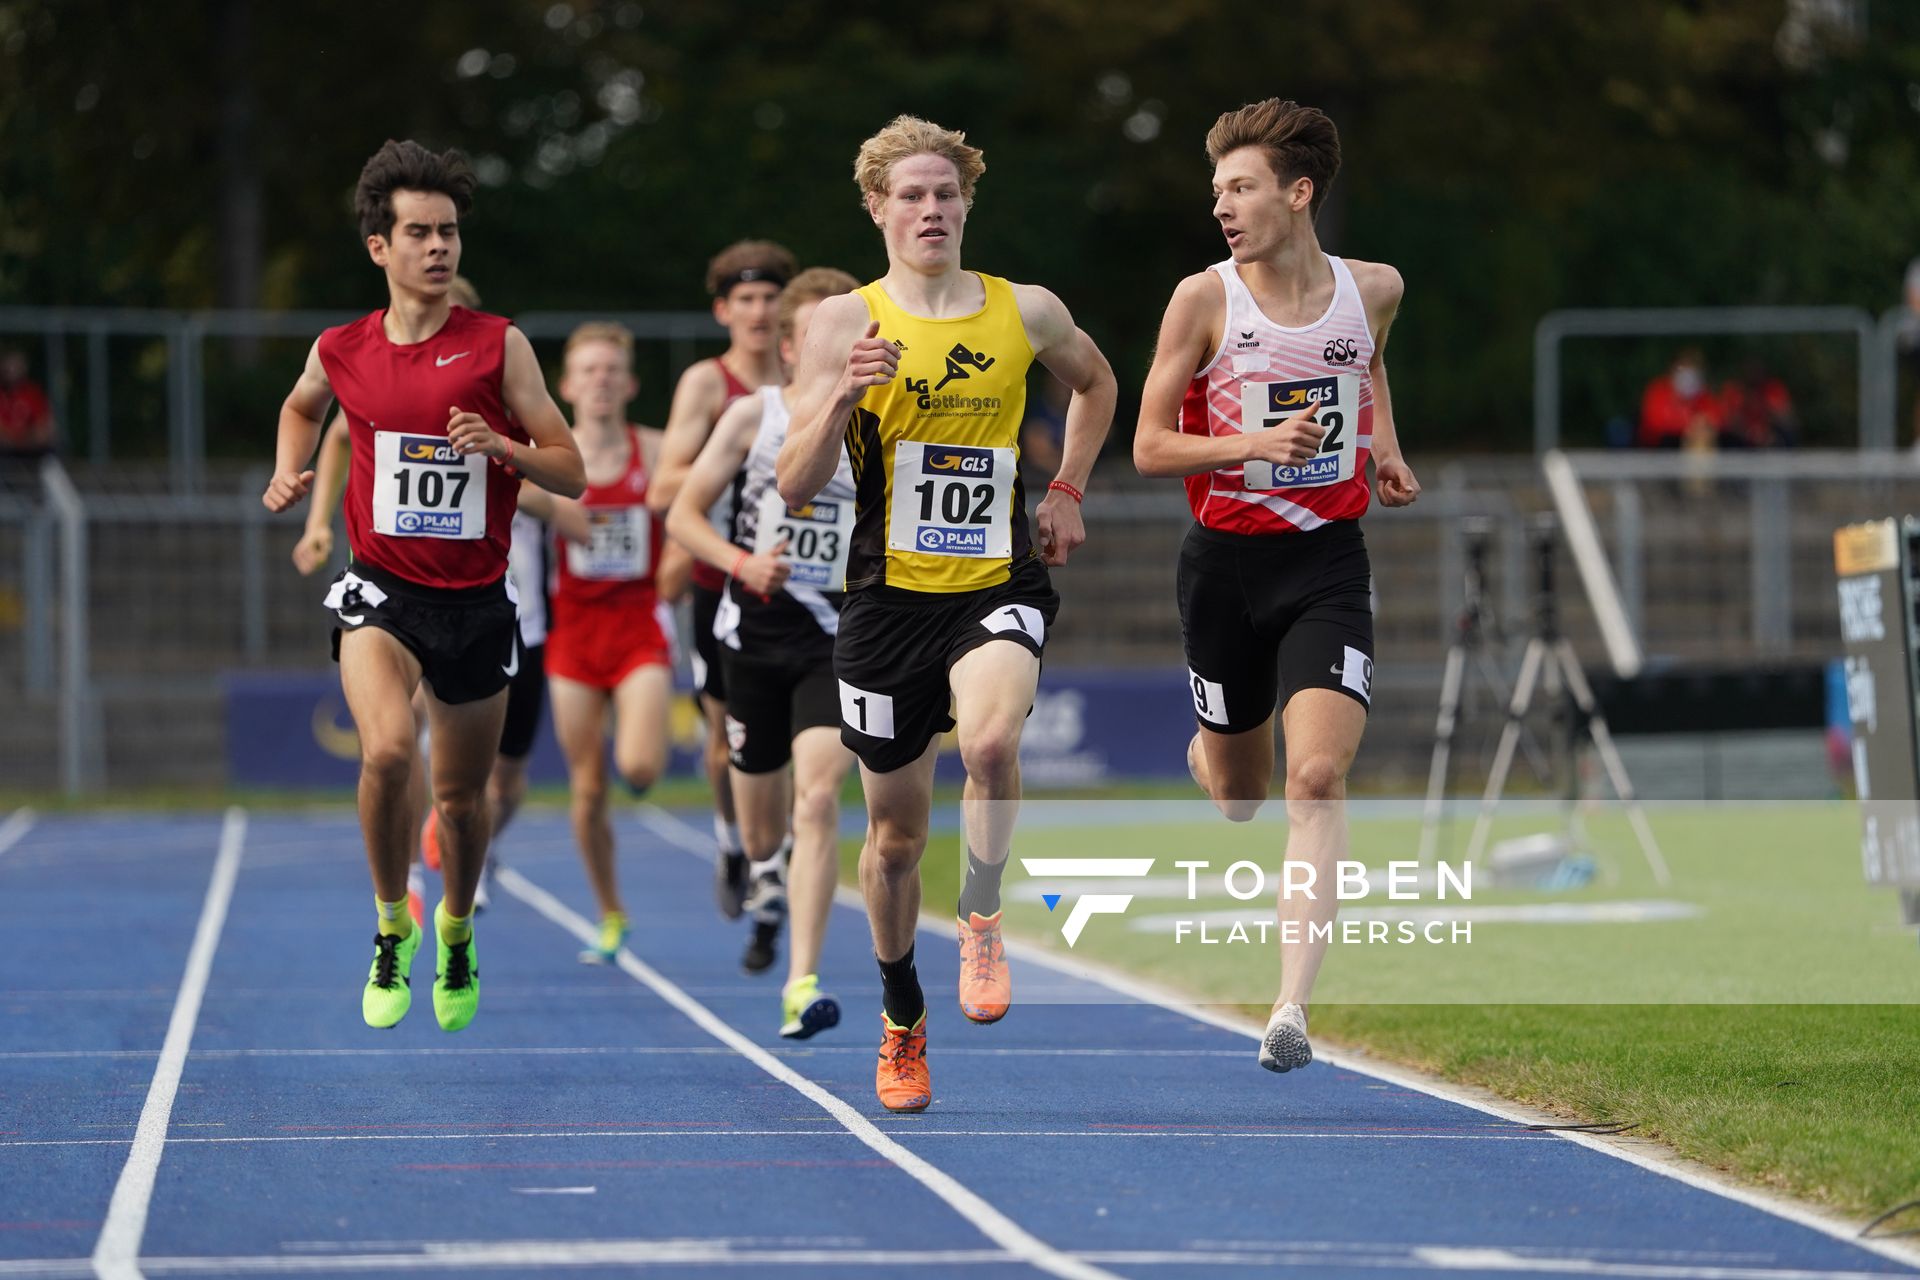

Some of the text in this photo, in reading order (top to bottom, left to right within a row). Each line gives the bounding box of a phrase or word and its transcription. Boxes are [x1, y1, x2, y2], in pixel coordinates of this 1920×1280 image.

[1237, 341, 1260, 349] erima
[905, 377, 929, 394] LG
[1306, 386, 1333, 402] GLS
[917, 393, 1002, 411] Göttingen
[961, 457, 989, 472] GLS
[1302, 460, 1337, 475] PLAN
[394, 468, 470, 508] 107
[914, 480, 995, 525] 102
[423, 515, 460, 528] PLAN
[777, 525, 839, 562] 203
[946, 532, 983, 545] PLAN
[1003, 607, 1028, 632] 1
[853, 696, 867, 732] 1
